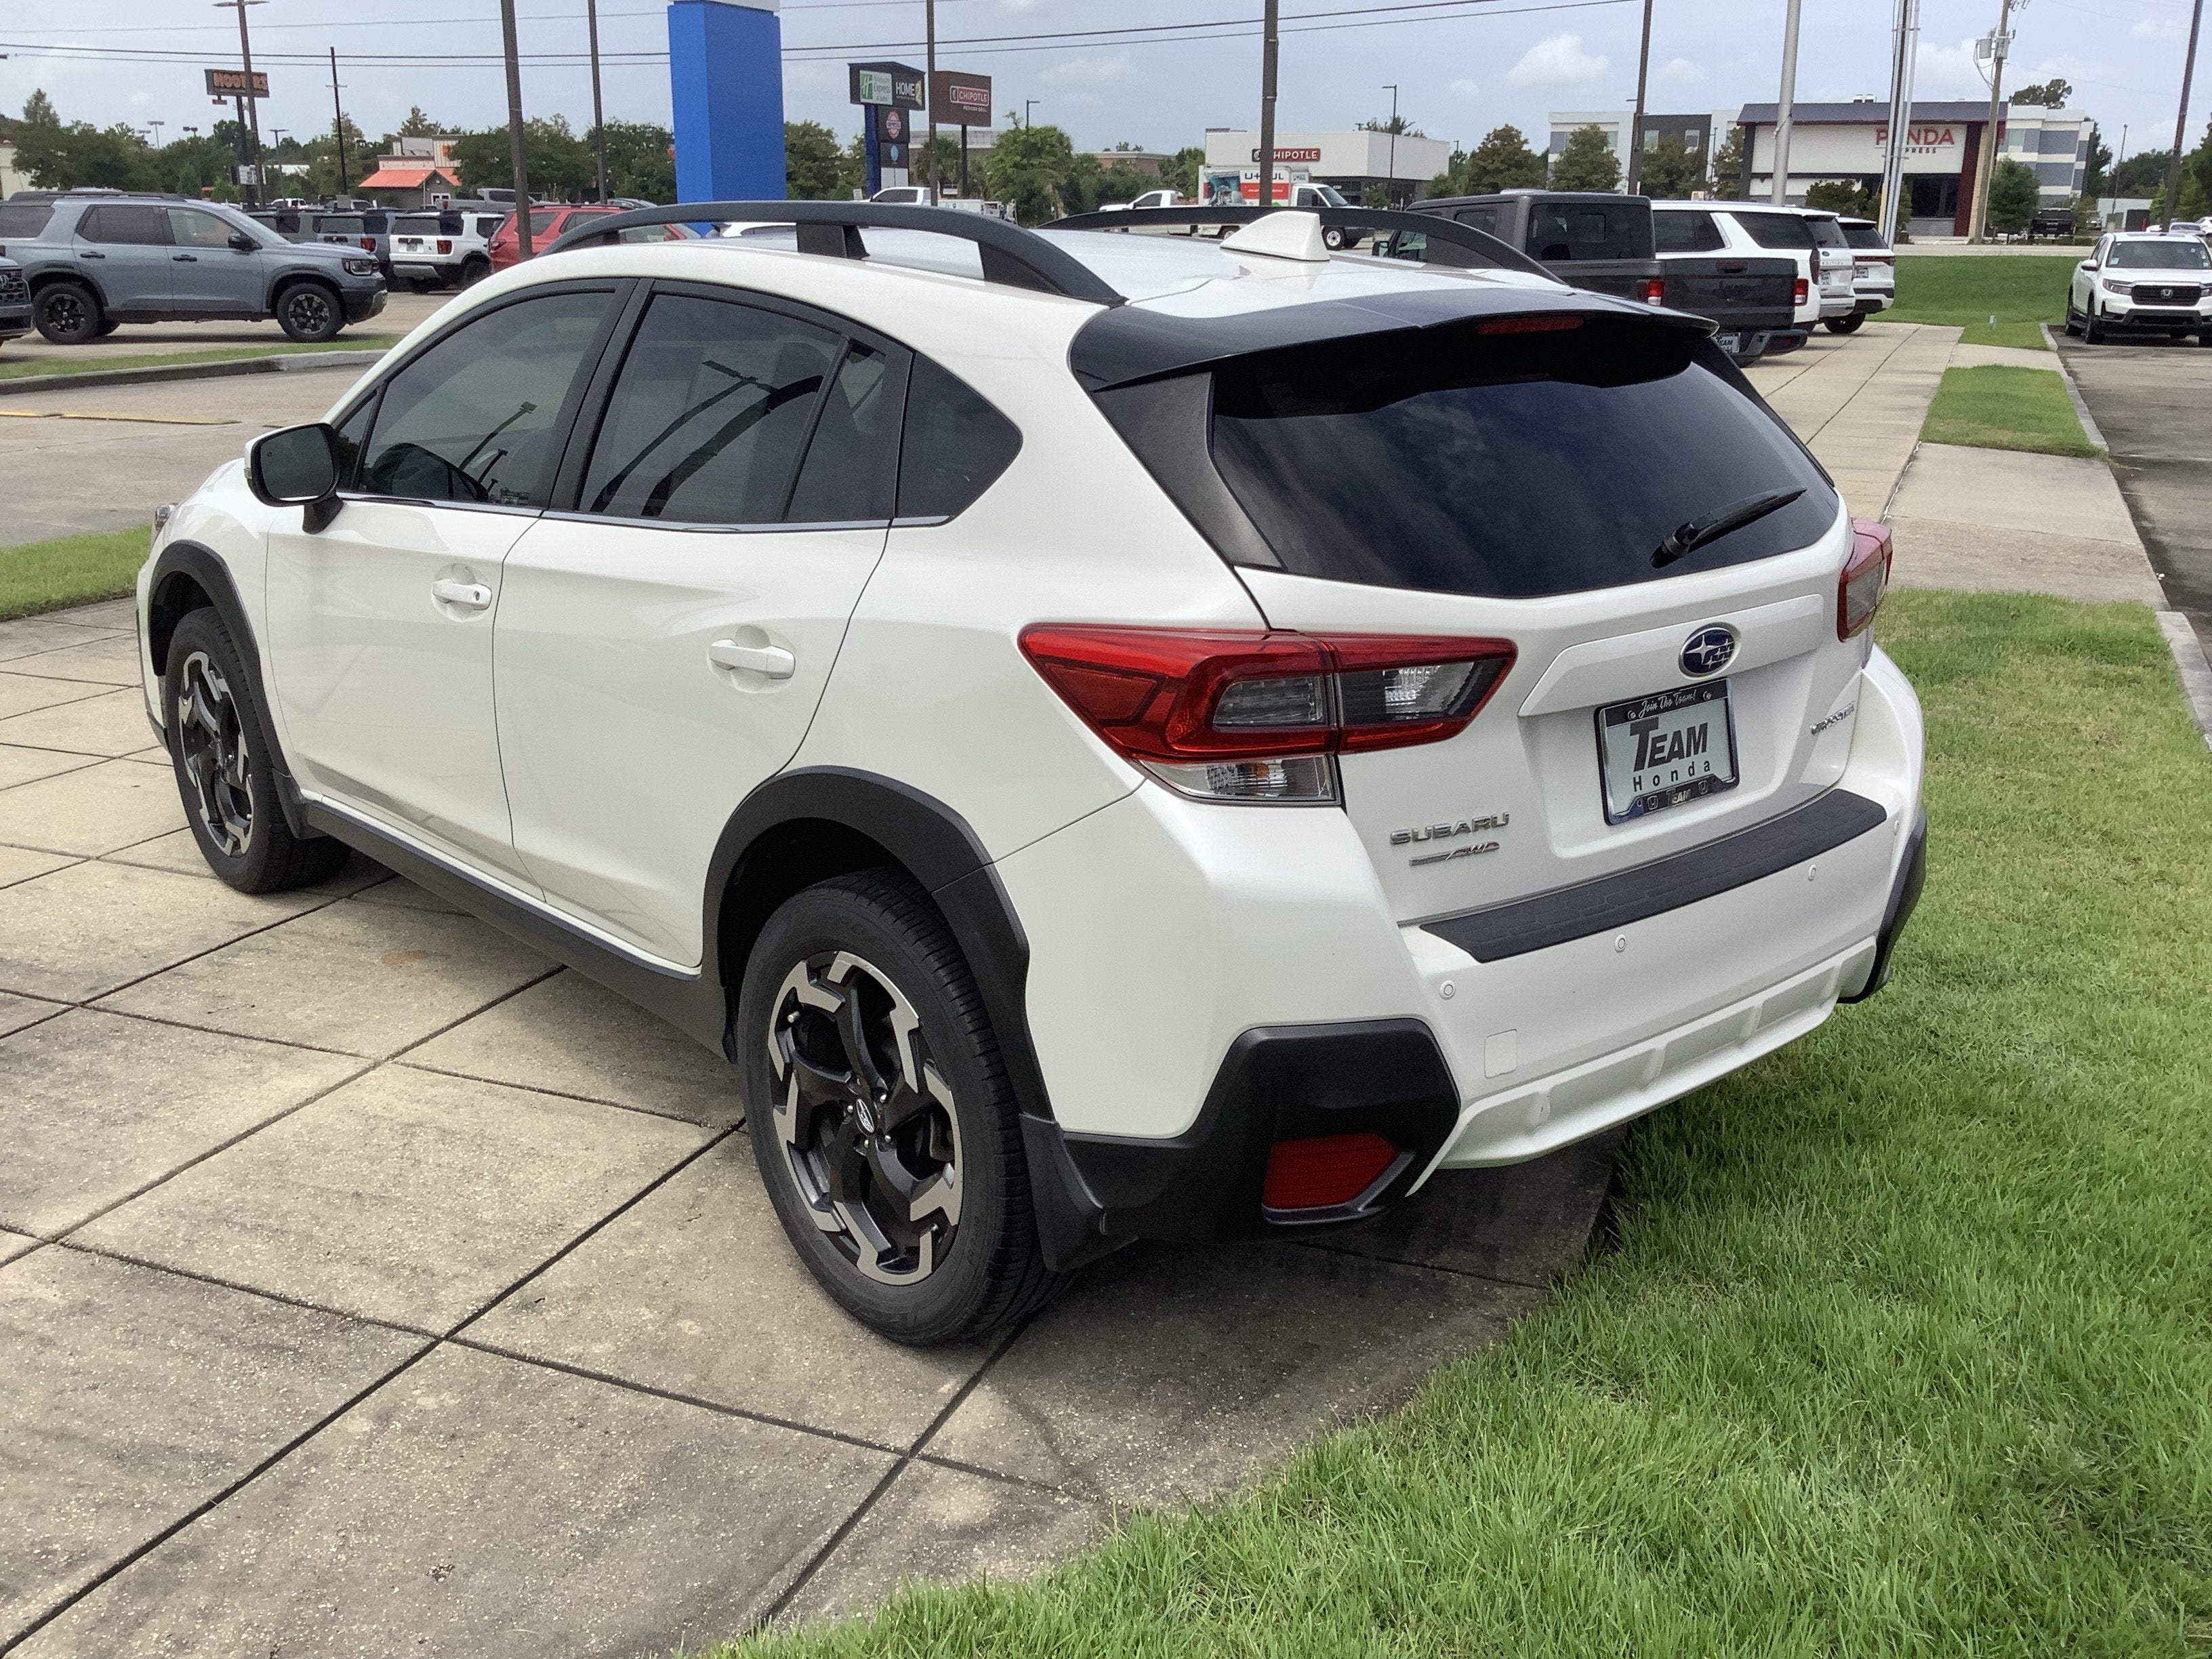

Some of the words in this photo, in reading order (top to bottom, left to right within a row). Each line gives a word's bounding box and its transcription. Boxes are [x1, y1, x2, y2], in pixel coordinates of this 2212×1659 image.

[895, 81, 915, 96] HOME
[959, 91, 987, 102] CHIPOTLE
[1875, 128, 1955, 146] PNDA
[1273, 150, 1318, 159] HIPOTLE
[1638, 700, 1658, 718] Join
[1629, 716, 1708, 773] TEAM
[1633, 760, 1711, 792] Honda
[1666, 788, 1692, 807] TEAM
[1389, 811, 1510, 845] SUBARU
